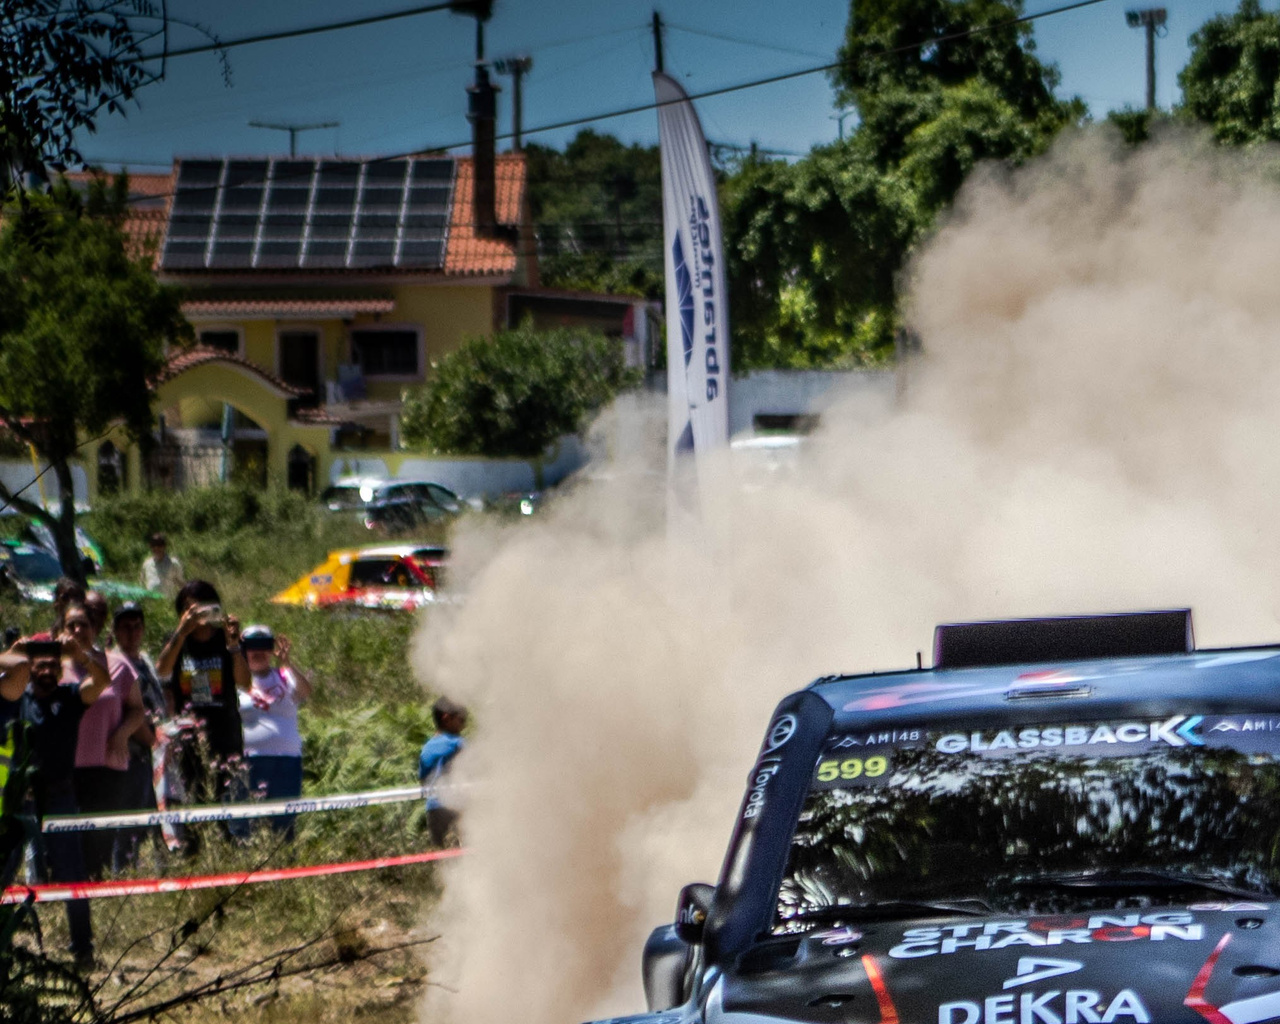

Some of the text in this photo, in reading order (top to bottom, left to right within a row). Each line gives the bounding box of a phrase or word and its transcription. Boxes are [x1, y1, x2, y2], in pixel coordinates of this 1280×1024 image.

[935, 715, 1188, 755] GLASSBACK
[816, 755, 888, 783] 599
[743, 765, 779, 819] Toyota
[888, 925, 1206, 959] CHARON
[902, 912, 1196, 943] STRONG
